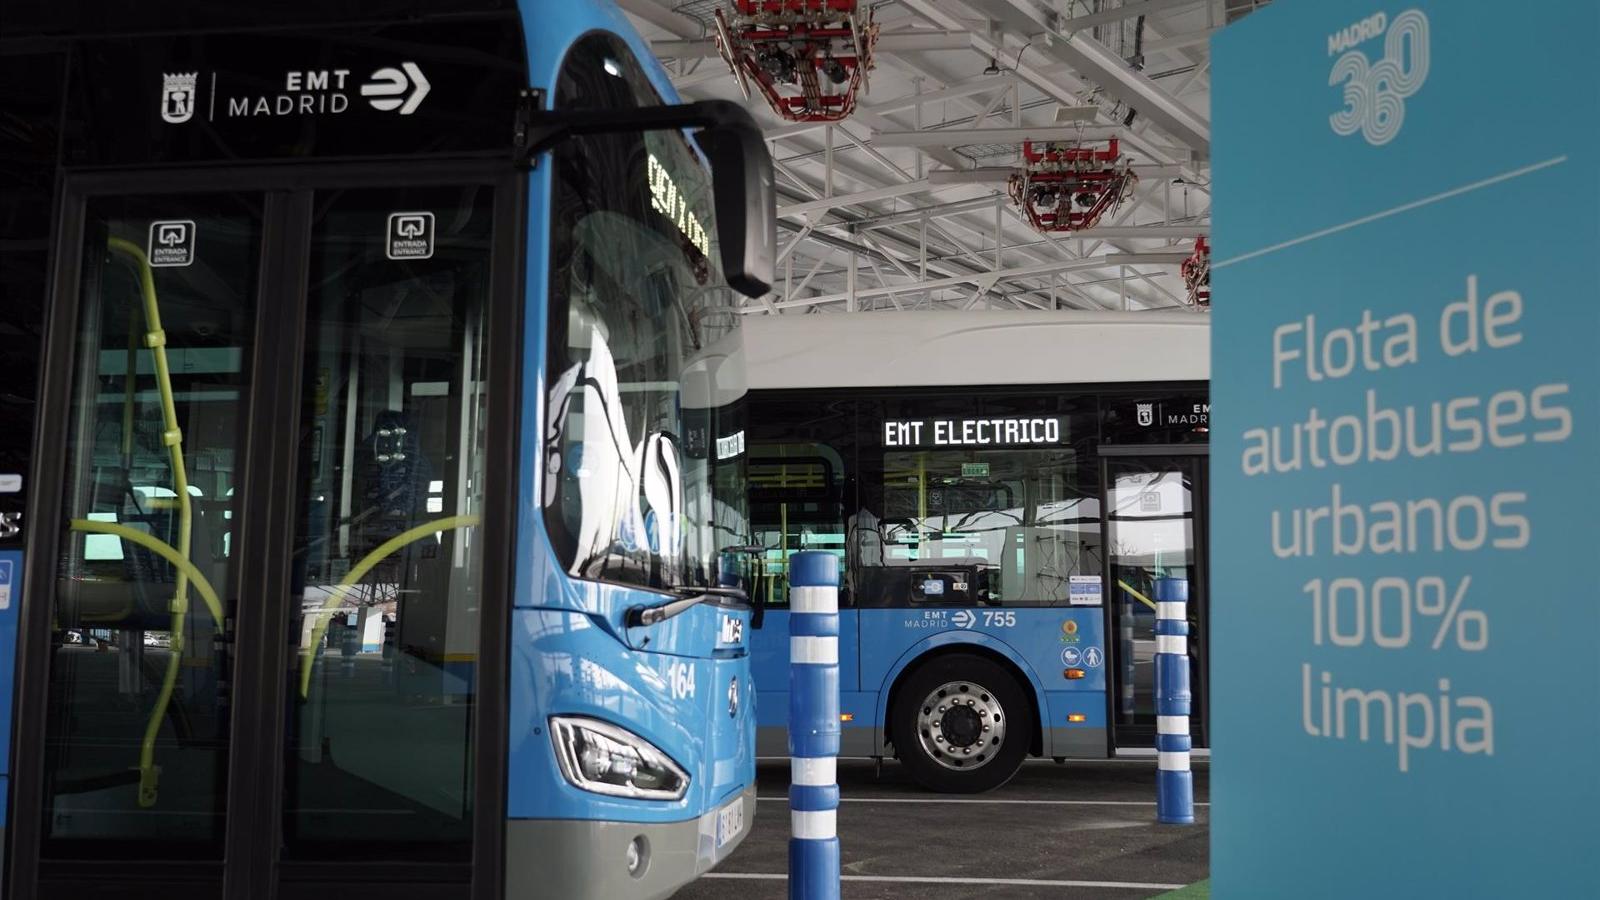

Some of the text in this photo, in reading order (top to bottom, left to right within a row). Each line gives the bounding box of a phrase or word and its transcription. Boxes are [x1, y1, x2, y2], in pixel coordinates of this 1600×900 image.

[1327, 11, 1387, 57] MADRID
[286, 69, 351, 92] EMT
[1328, 8, 1430, 146] 360
[228, 93, 349, 117] MADRID
[154, 247, 188, 255] ENTRADA
[393, 240, 428, 248] ENTRADA
[153, 255, 187, 263] ENTRANCE
[1272, 274, 1523, 389] Flota de
[885, 418, 1060, 446] EMT ELECTRICO
[1241, 383, 1573, 476] autobuses
[1271, 483, 1531, 559] urbanos
[904, 619, 949, 629] MADRID
[924, 611, 947, 620] EMT
[982, 610, 1016, 628] 755
[1302, 575, 1489, 652] 100%
[668, 662, 695, 700] 164
[1301, 663, 1494, 772] limpia
